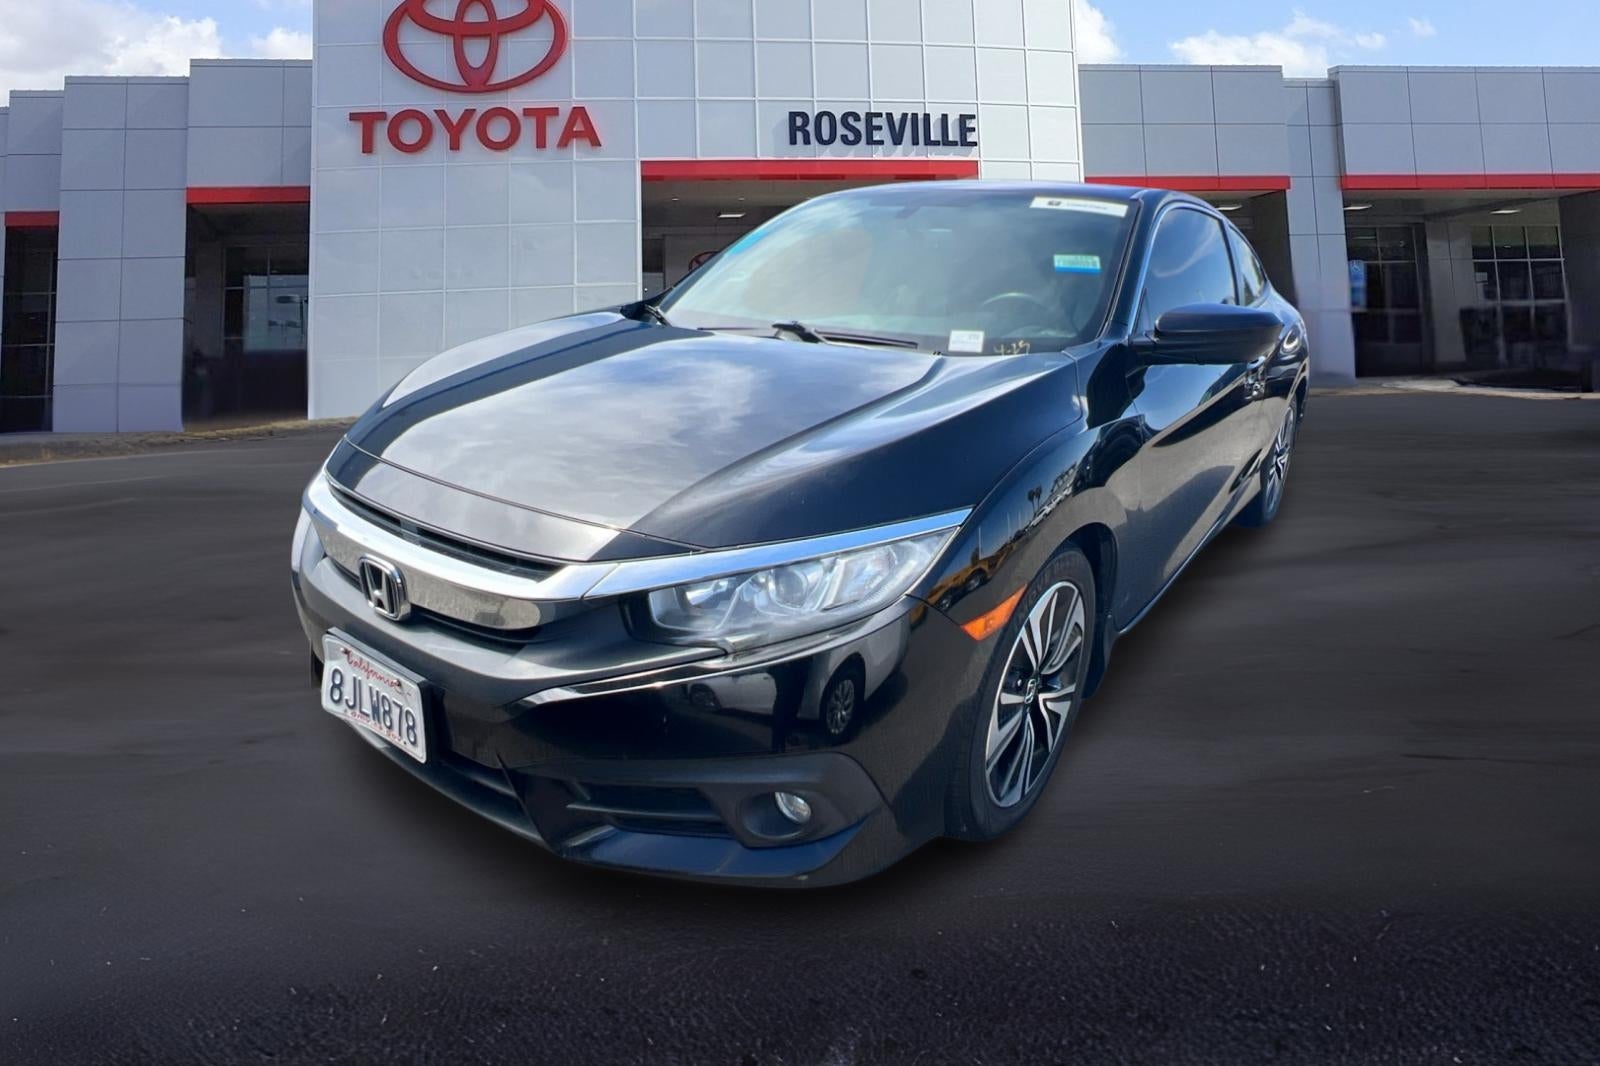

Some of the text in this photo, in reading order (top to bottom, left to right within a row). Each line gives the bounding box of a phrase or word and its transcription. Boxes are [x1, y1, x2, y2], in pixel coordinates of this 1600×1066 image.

[349, 106, 602, 153] TOYOTA
[788, 111, 978, 147] ROSEVILLE
[330, 668, 417, 746] 8JLW878
